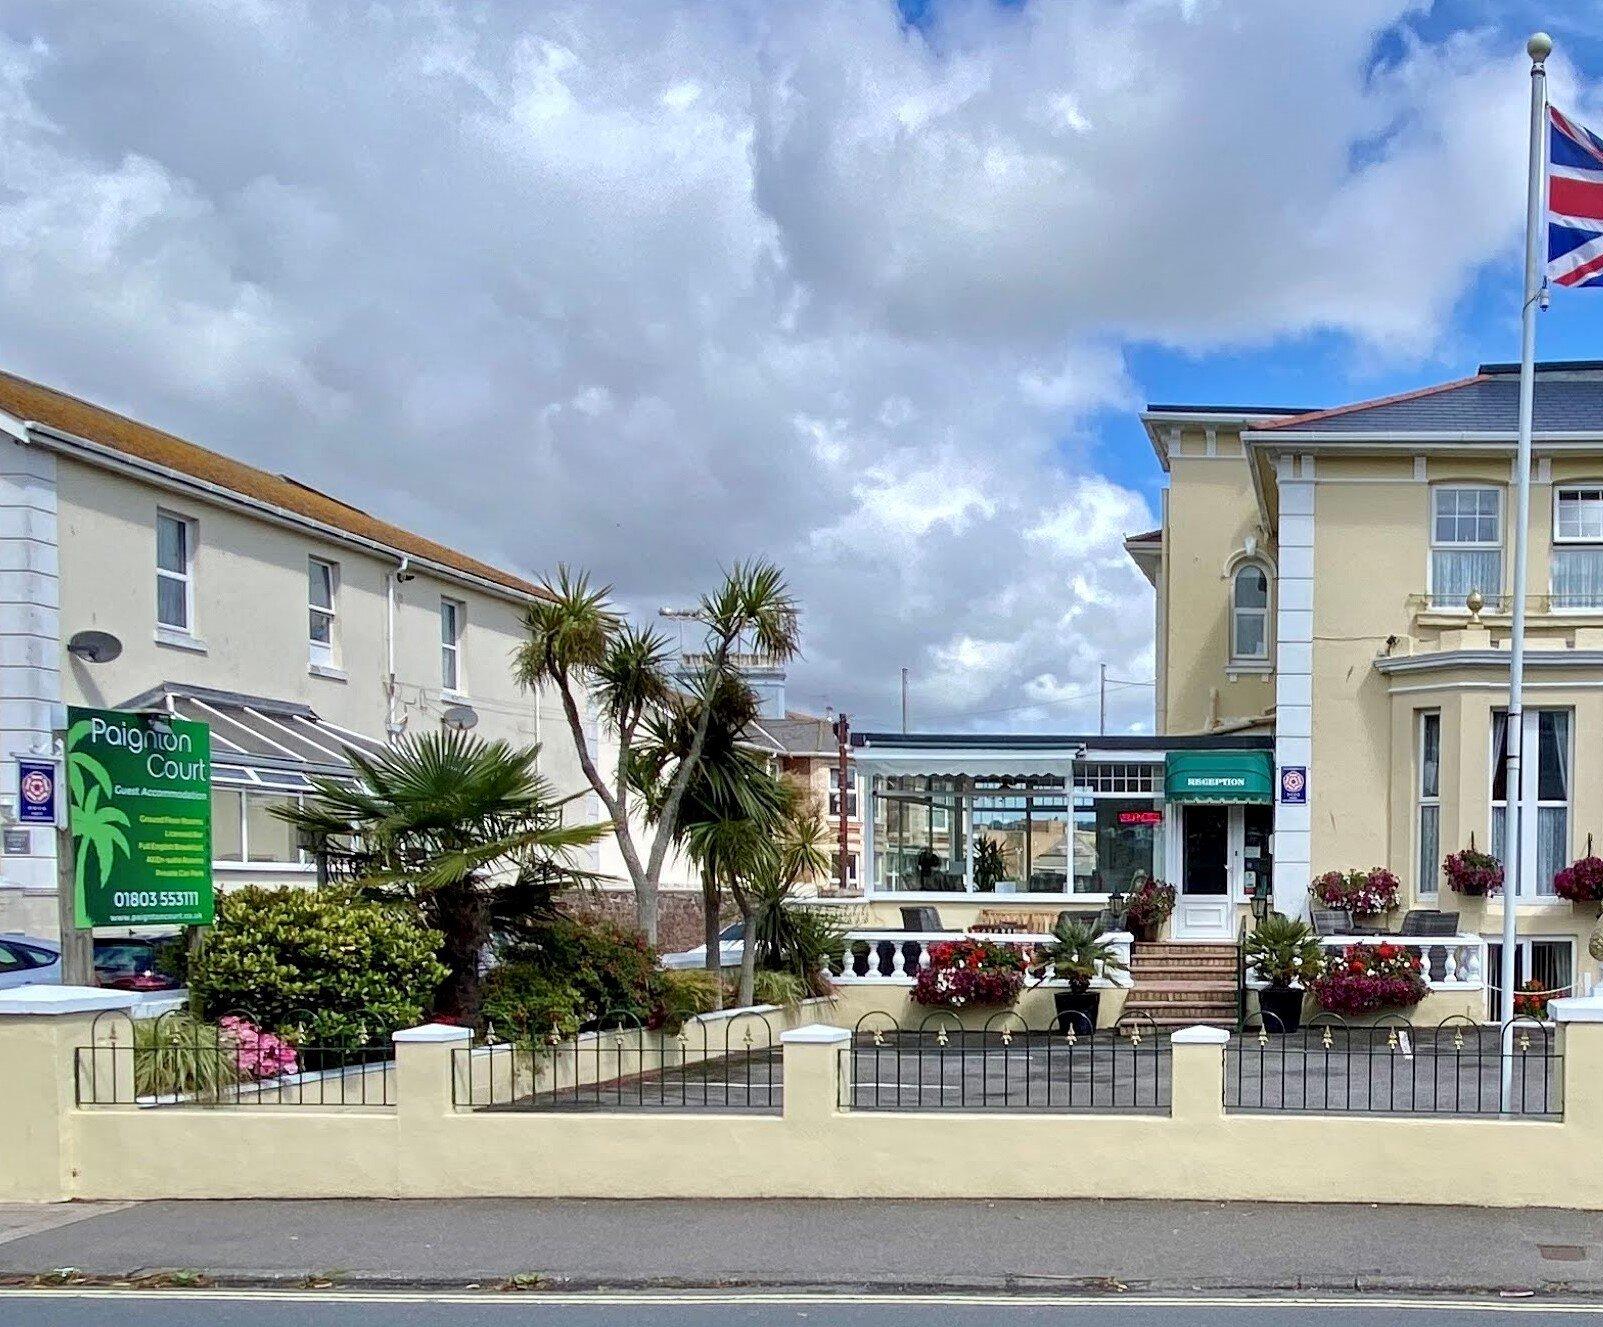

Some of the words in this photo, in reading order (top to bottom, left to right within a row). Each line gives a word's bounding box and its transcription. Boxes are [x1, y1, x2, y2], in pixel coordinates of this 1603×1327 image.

[91, 717, 192, 754] Paignton
[147, 754, 207, 782] Court
[1187, 777, 1245, 786] RECEPTION
[114, 891, 158, 908] 01803
[159, 891, 199, 907] 553111
